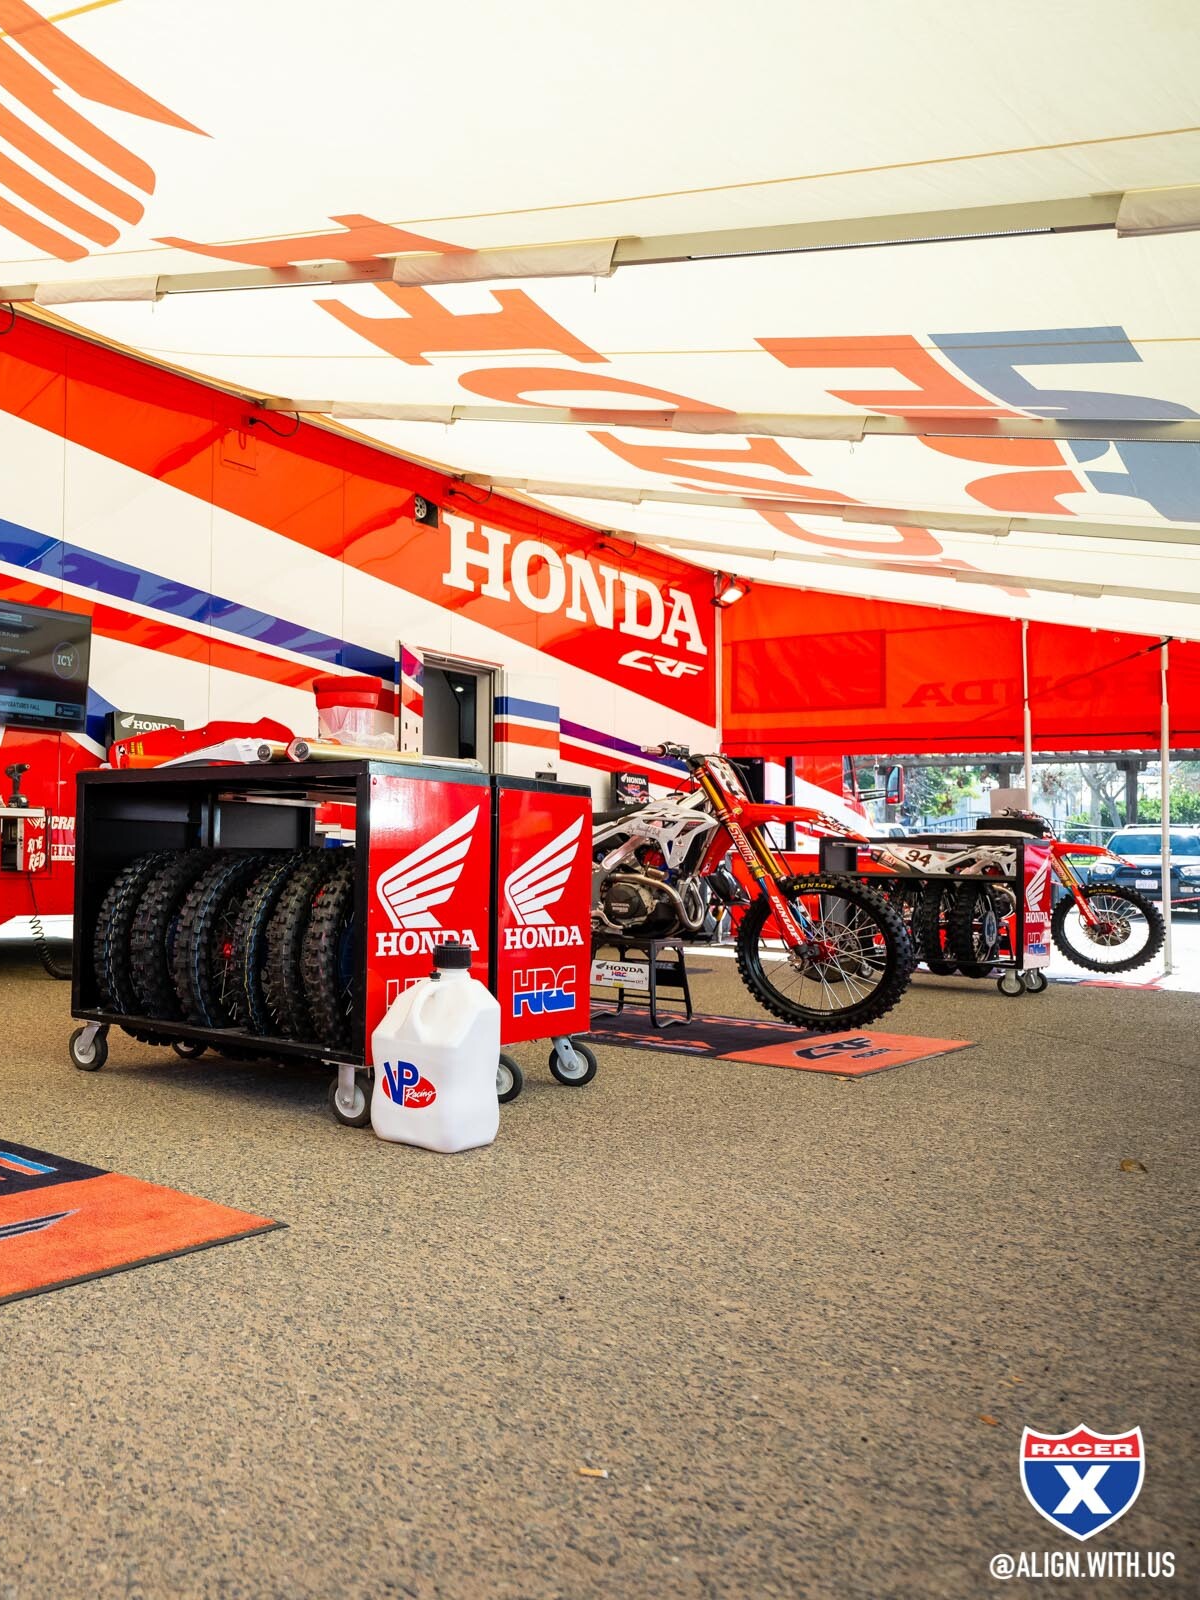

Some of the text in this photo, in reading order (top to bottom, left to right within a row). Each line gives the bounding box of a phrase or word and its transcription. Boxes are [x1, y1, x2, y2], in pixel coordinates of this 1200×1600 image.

[442, 513, 708, 655] HONDA
[618, 650, 705, 679] CRF
[626, 776, 647, 786] HONDA
[728, 826, 754, 866] SHOWA
[793, 882, 836, 891] DUNLOP
[771, 895, 804, 945] DUNLOP
[1025, 911, 1049, 924] HONDA
[504, 925, 584, 950] HONDA
[605, 964, 644, 974] HONDA
[513, 965, 576, 1018] HRC
[383, 1060, 420, 1107] VP
[404, 1087, 437, 1103] Racing
